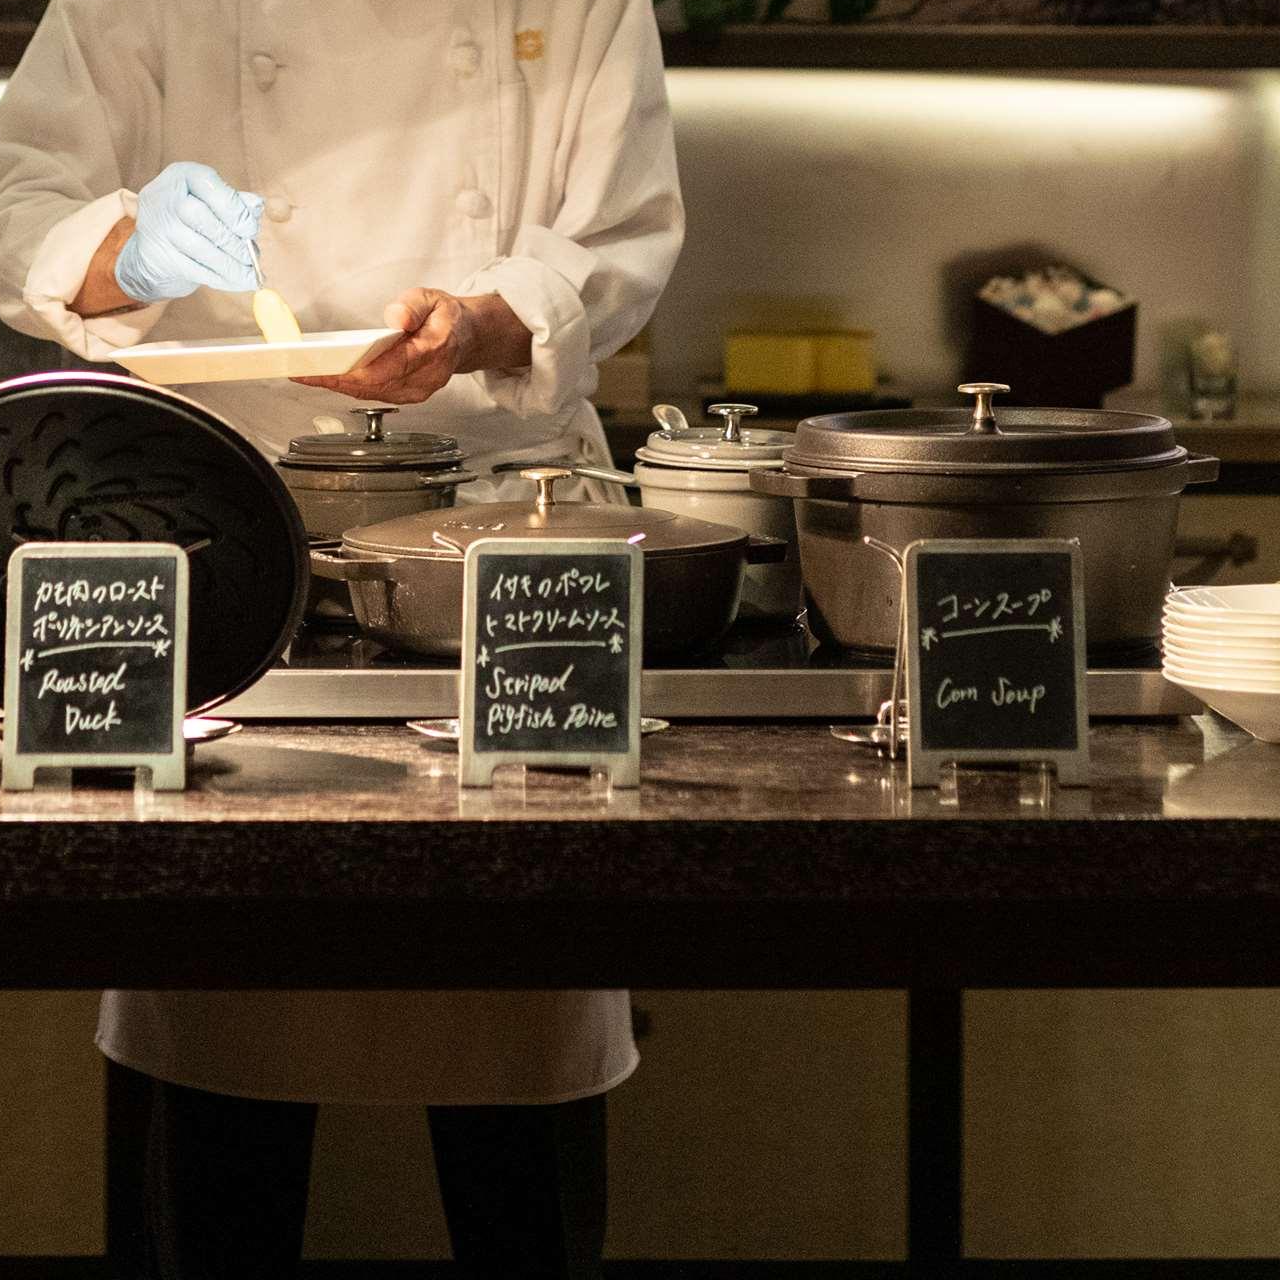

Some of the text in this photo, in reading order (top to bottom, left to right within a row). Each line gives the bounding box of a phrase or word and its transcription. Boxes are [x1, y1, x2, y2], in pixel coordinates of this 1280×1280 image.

[486, 607, 626, 638] トマトクリームソース
[937, 588, 1053, 623] コーンスープ
[485, 664, 574, 702] Striped
[937, 676, 1046, 713] Corn Soup
[65, 699, 122, 735] Duck
